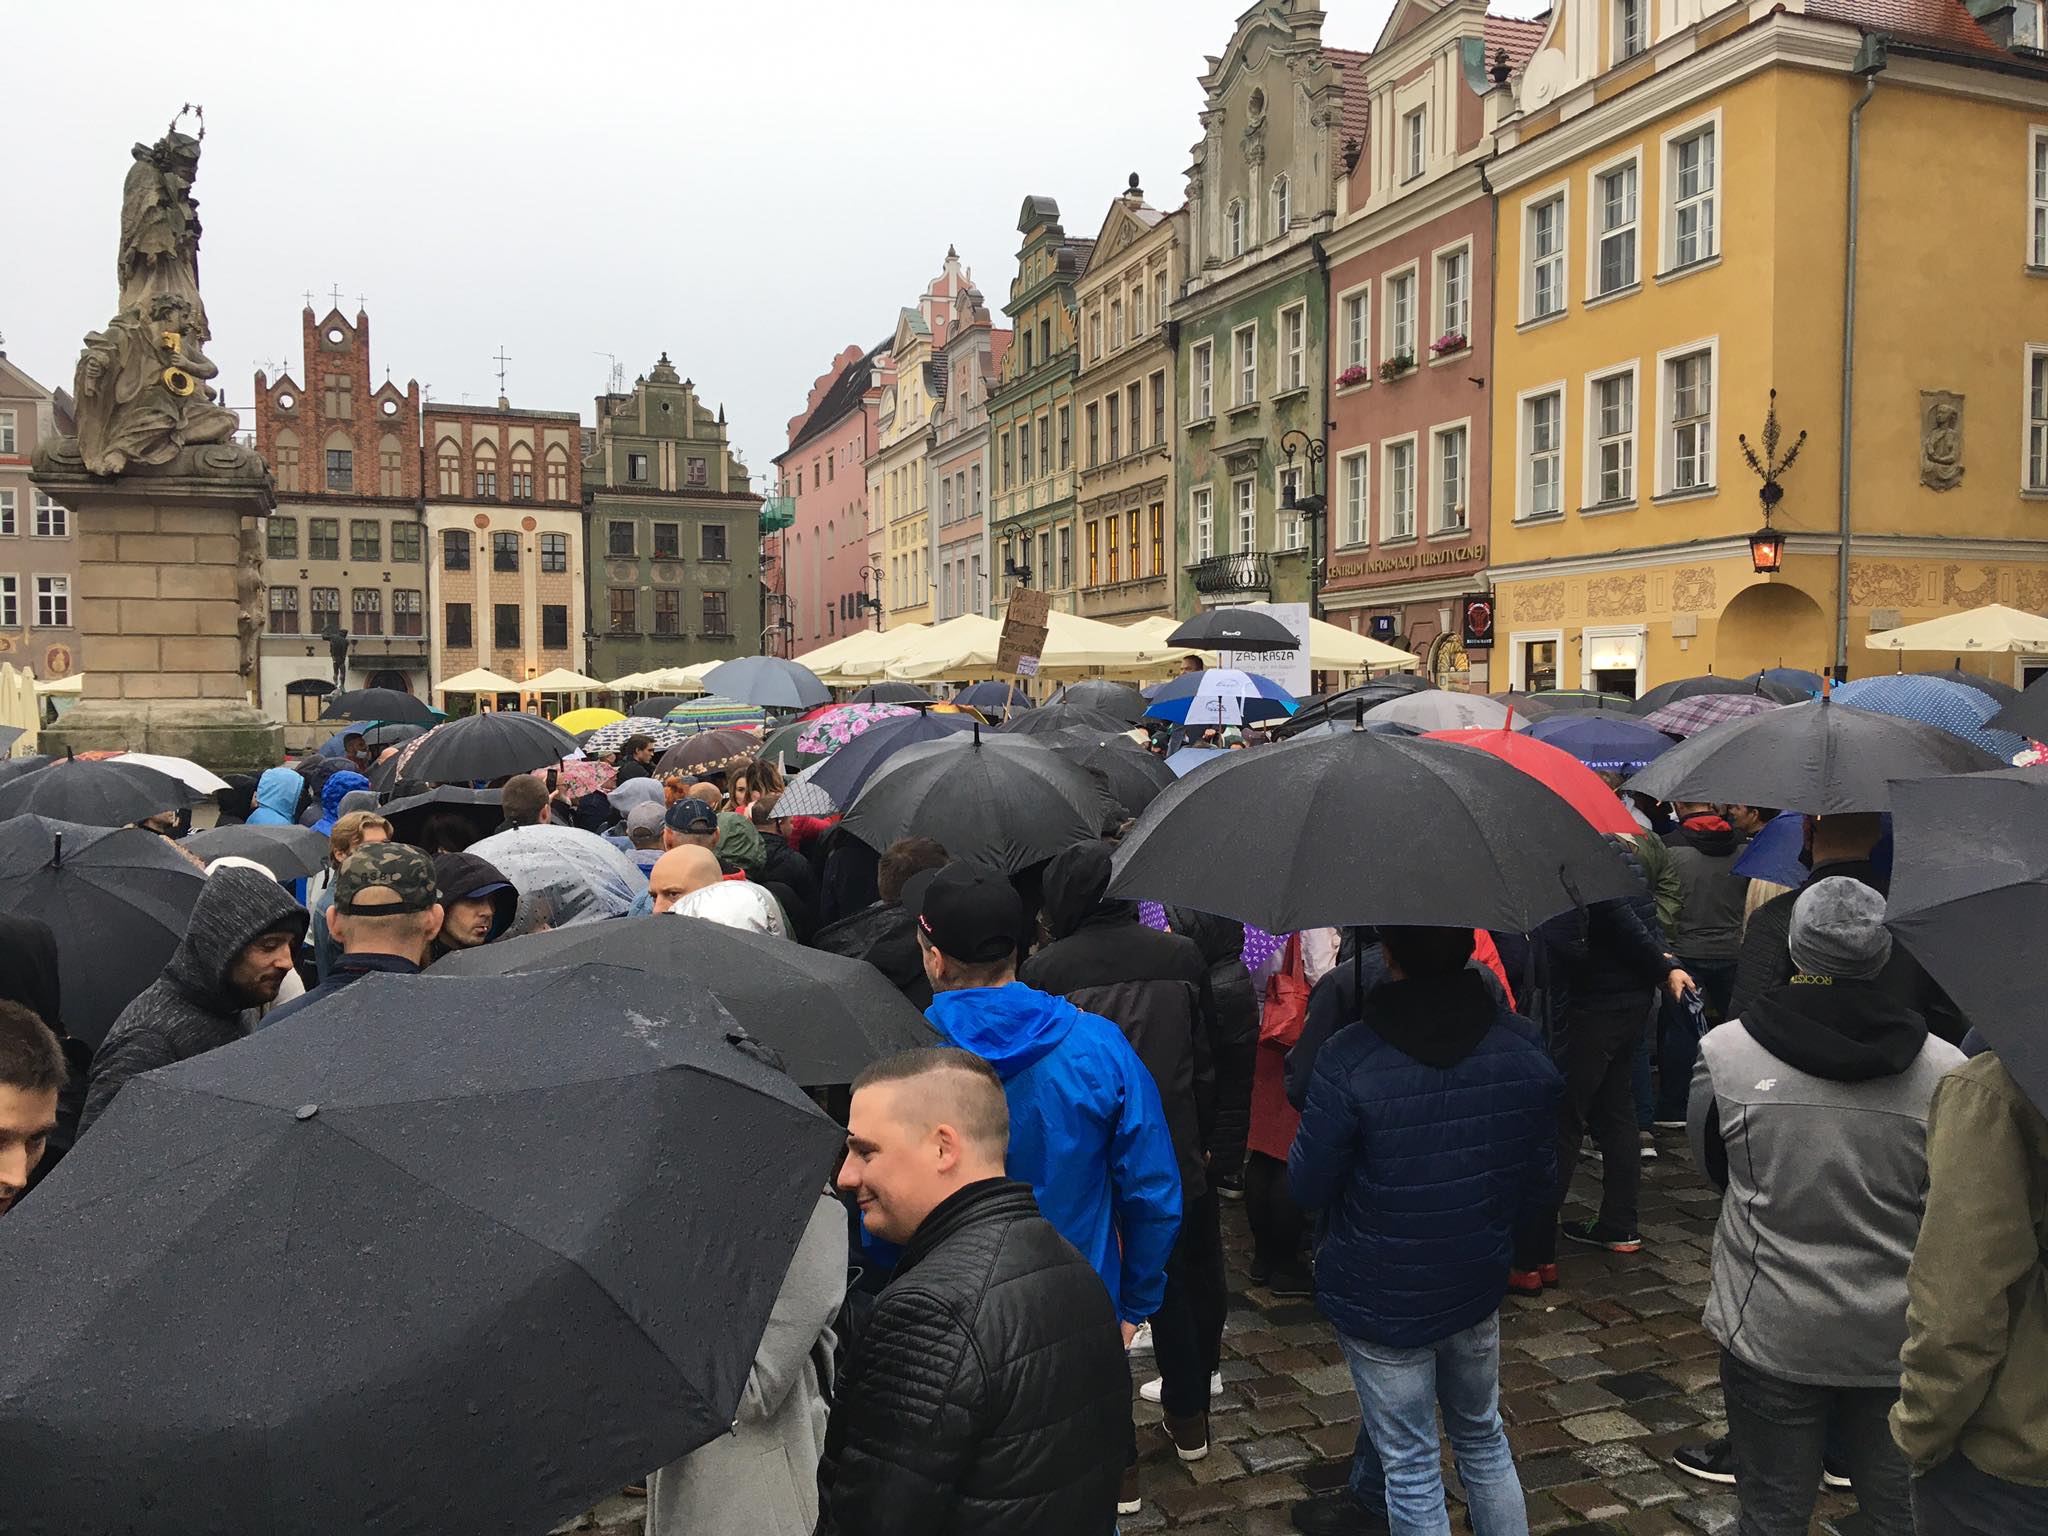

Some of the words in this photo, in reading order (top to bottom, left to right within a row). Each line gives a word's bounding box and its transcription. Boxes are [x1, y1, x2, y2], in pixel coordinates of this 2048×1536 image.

[1328, 562, 1364, 578] CENTRUM
[1366, 554, 1416, 573] INFORMACJI
[1418, 544, 1484, 566] TURYSTYCZNEJ
[1235, 651, 1295, 662] ZASTRASZA
[1790, 974, 1833, 986] ROCKST
[1754, 1078, 1777, 1091] 4F
